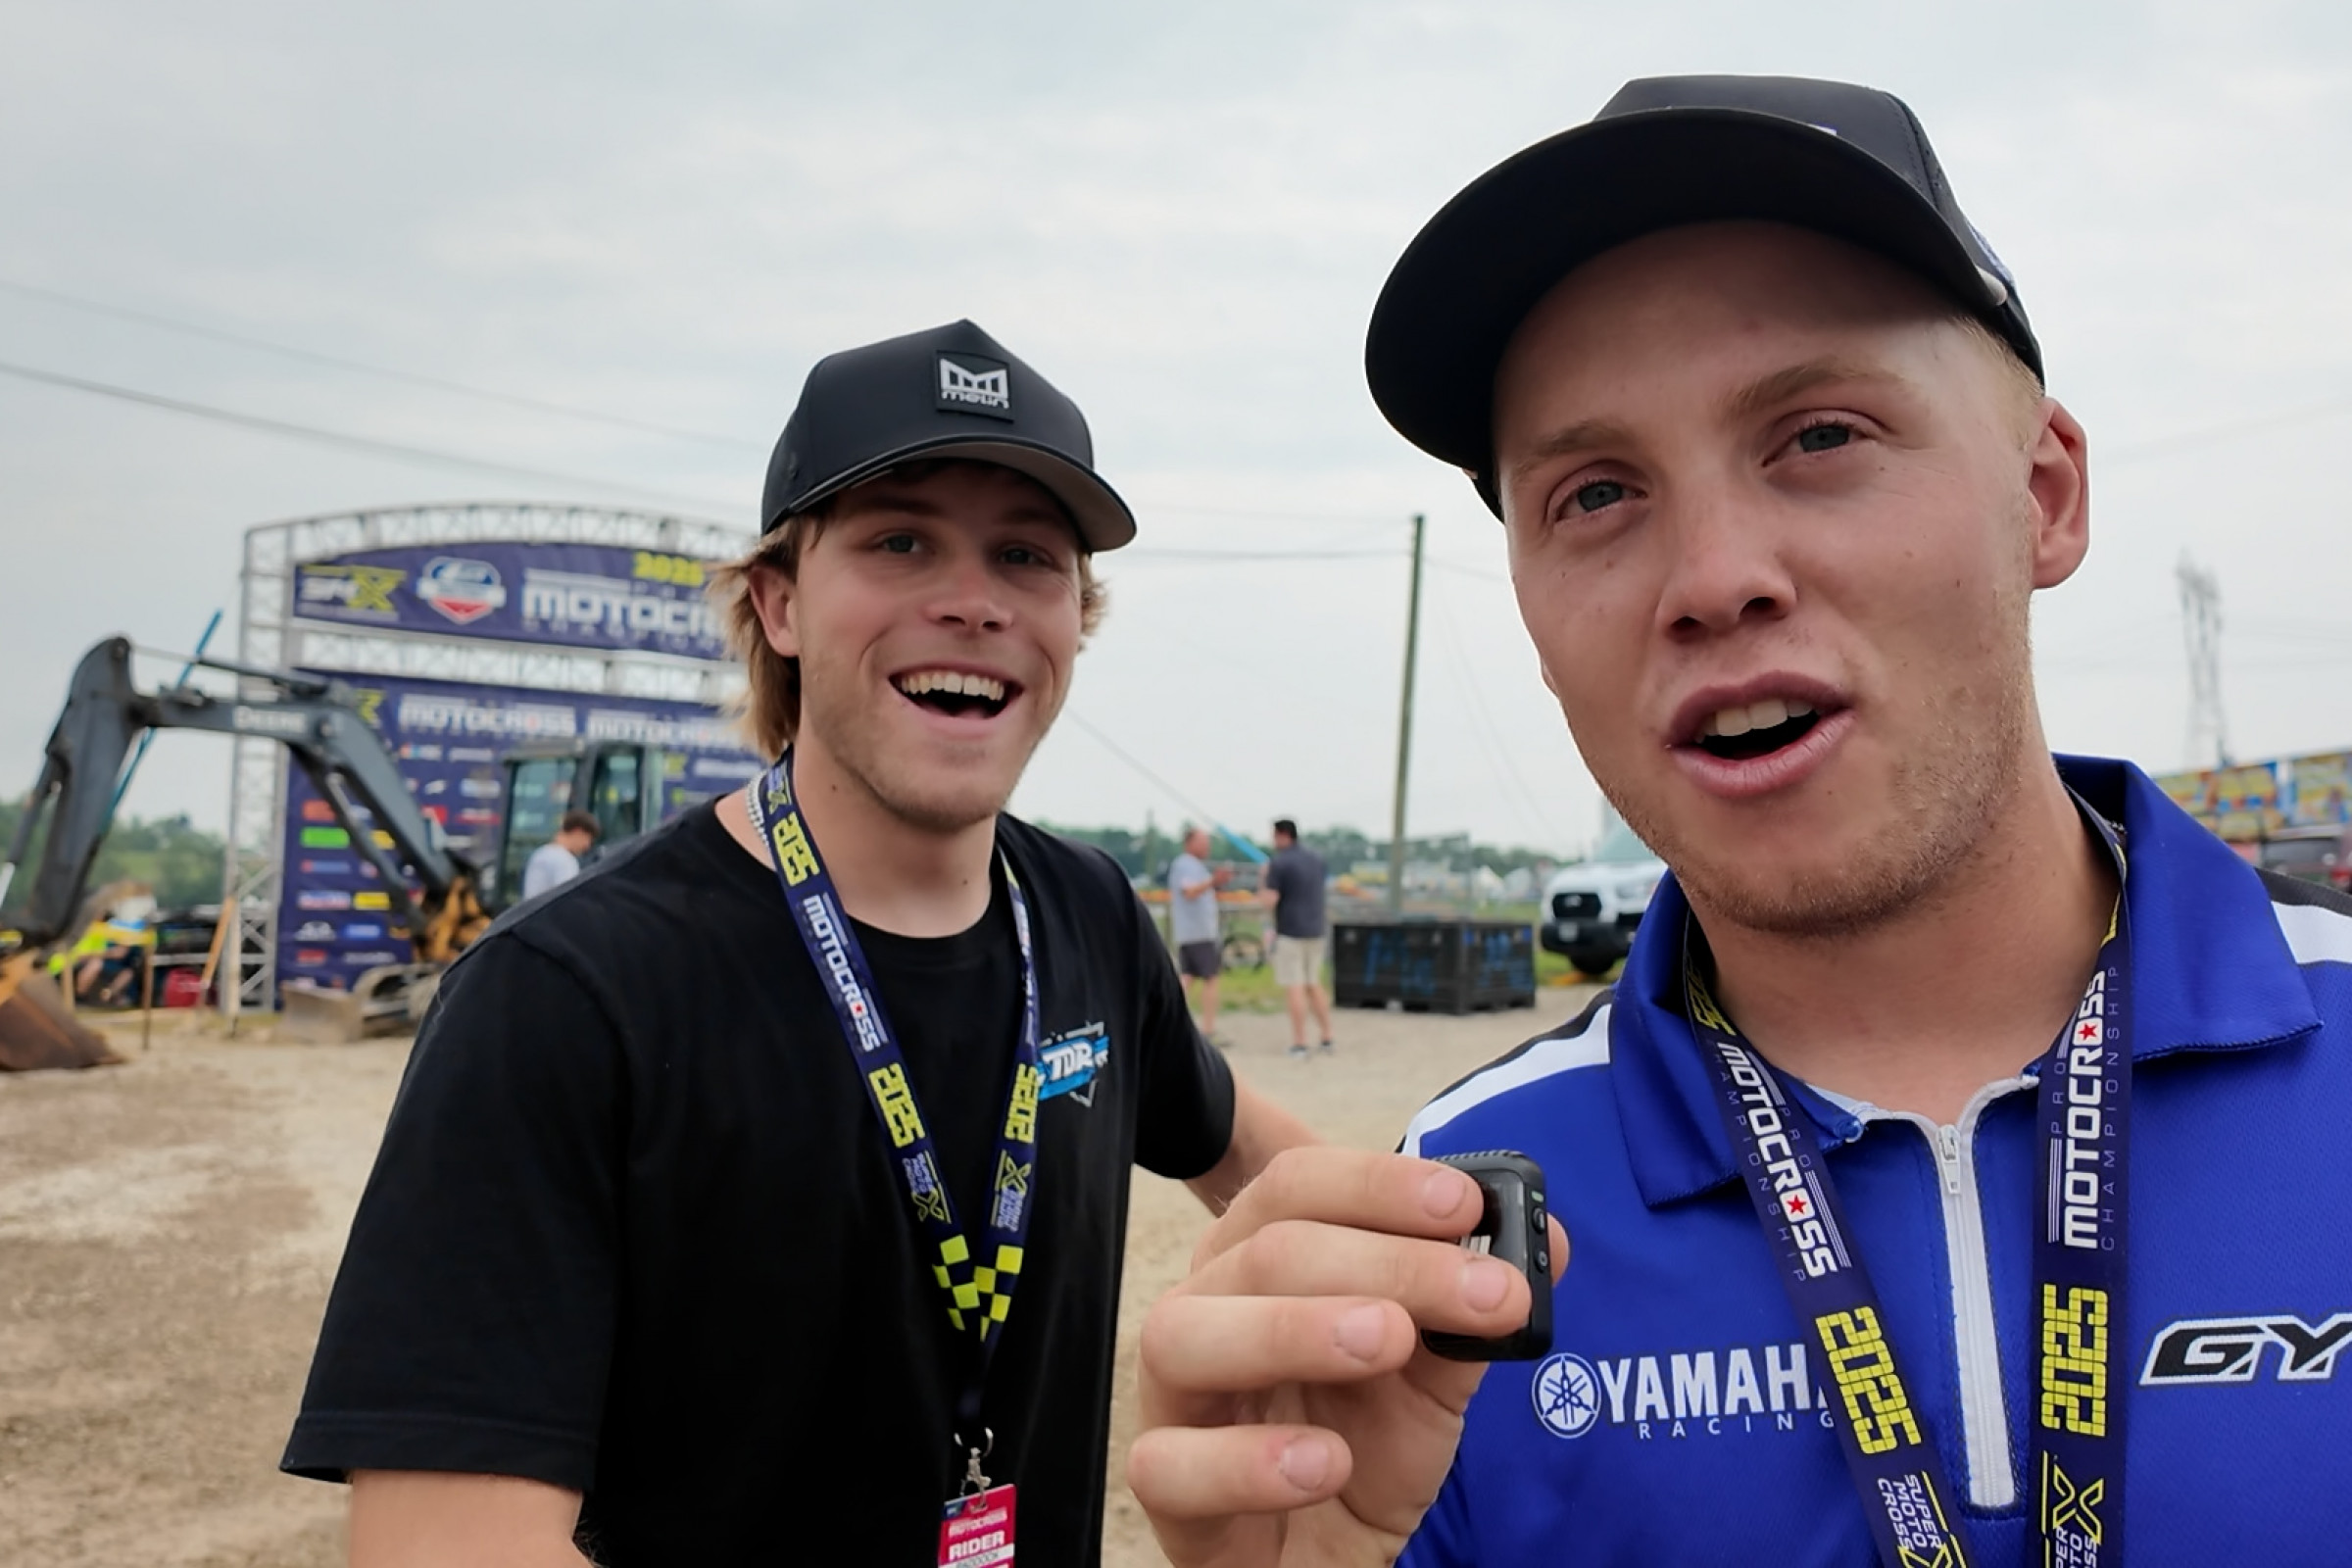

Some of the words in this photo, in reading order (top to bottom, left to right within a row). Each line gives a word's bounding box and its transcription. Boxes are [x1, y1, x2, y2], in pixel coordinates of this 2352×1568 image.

[772, 811, 820, 886] 2025
[803, 894, 881, 1052] MOTOCROSS
[868, 1062, 925, 1148] 2025
[1004, 1063, 1039, 1144] 2025
[1781, 1106, 1811, 1168] PRO
[2051, 1061, 2066, 1134] PRO
[2064, 970, 2105, 1250] MOTOCROSS
[2101, 966, 2121, 1251] CHAMPIONSHIP
[1717, 1042, 1838, 1278] MOTOCROSS
[1597, 1344, 1828, 1424] YAMAH
[1816, 1306, 1922, 1454] 2025
[2041, 1283, 2108, 1437] 2025
[1640, 1409, 1836, 1440] RACING
[949, 1530, 1005, 1562] RIDER
[1878, 1478, 1915, 1550] CROSS
[1892, 1481, 1928, 1547] MOTO
[1904, 1474, 1942, 1548] SUPER
